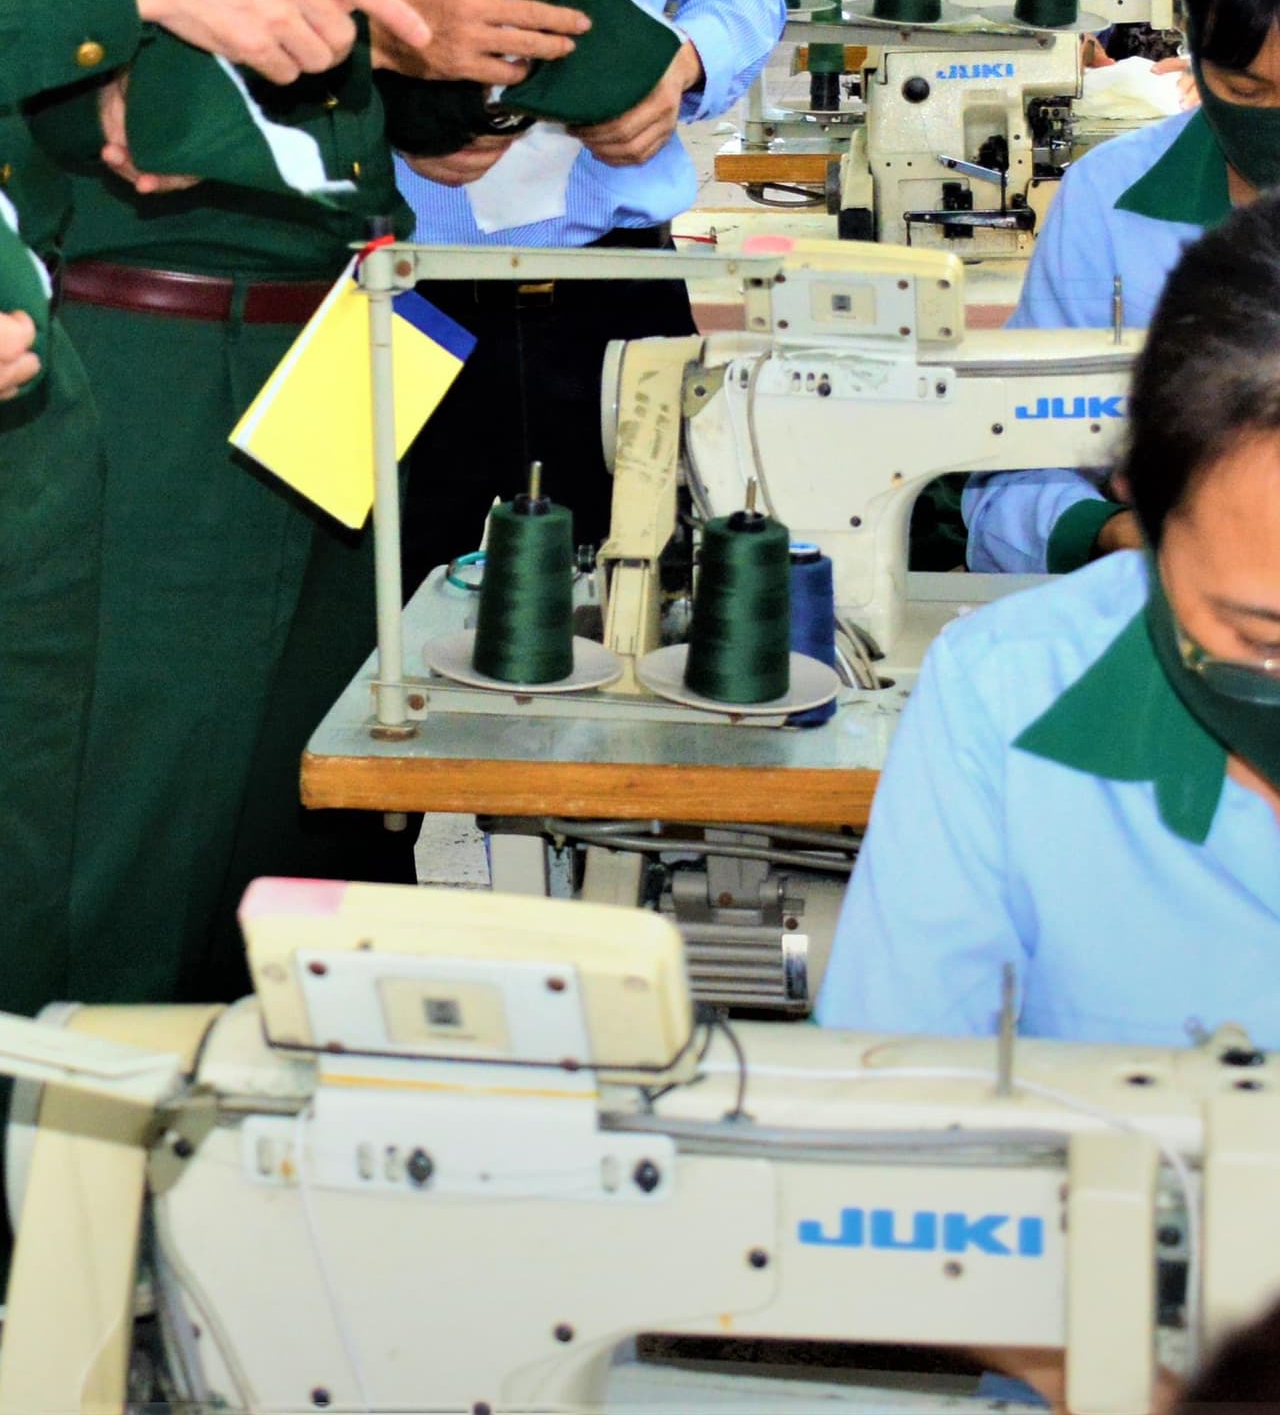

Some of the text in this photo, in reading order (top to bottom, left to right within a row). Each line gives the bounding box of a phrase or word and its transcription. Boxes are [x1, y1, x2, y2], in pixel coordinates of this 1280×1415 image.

[936, 62, 1015, 80] JUKI
[1015, 395, 1125, 419] JUK
[797, 1207, 1043, 1258] JUKI
